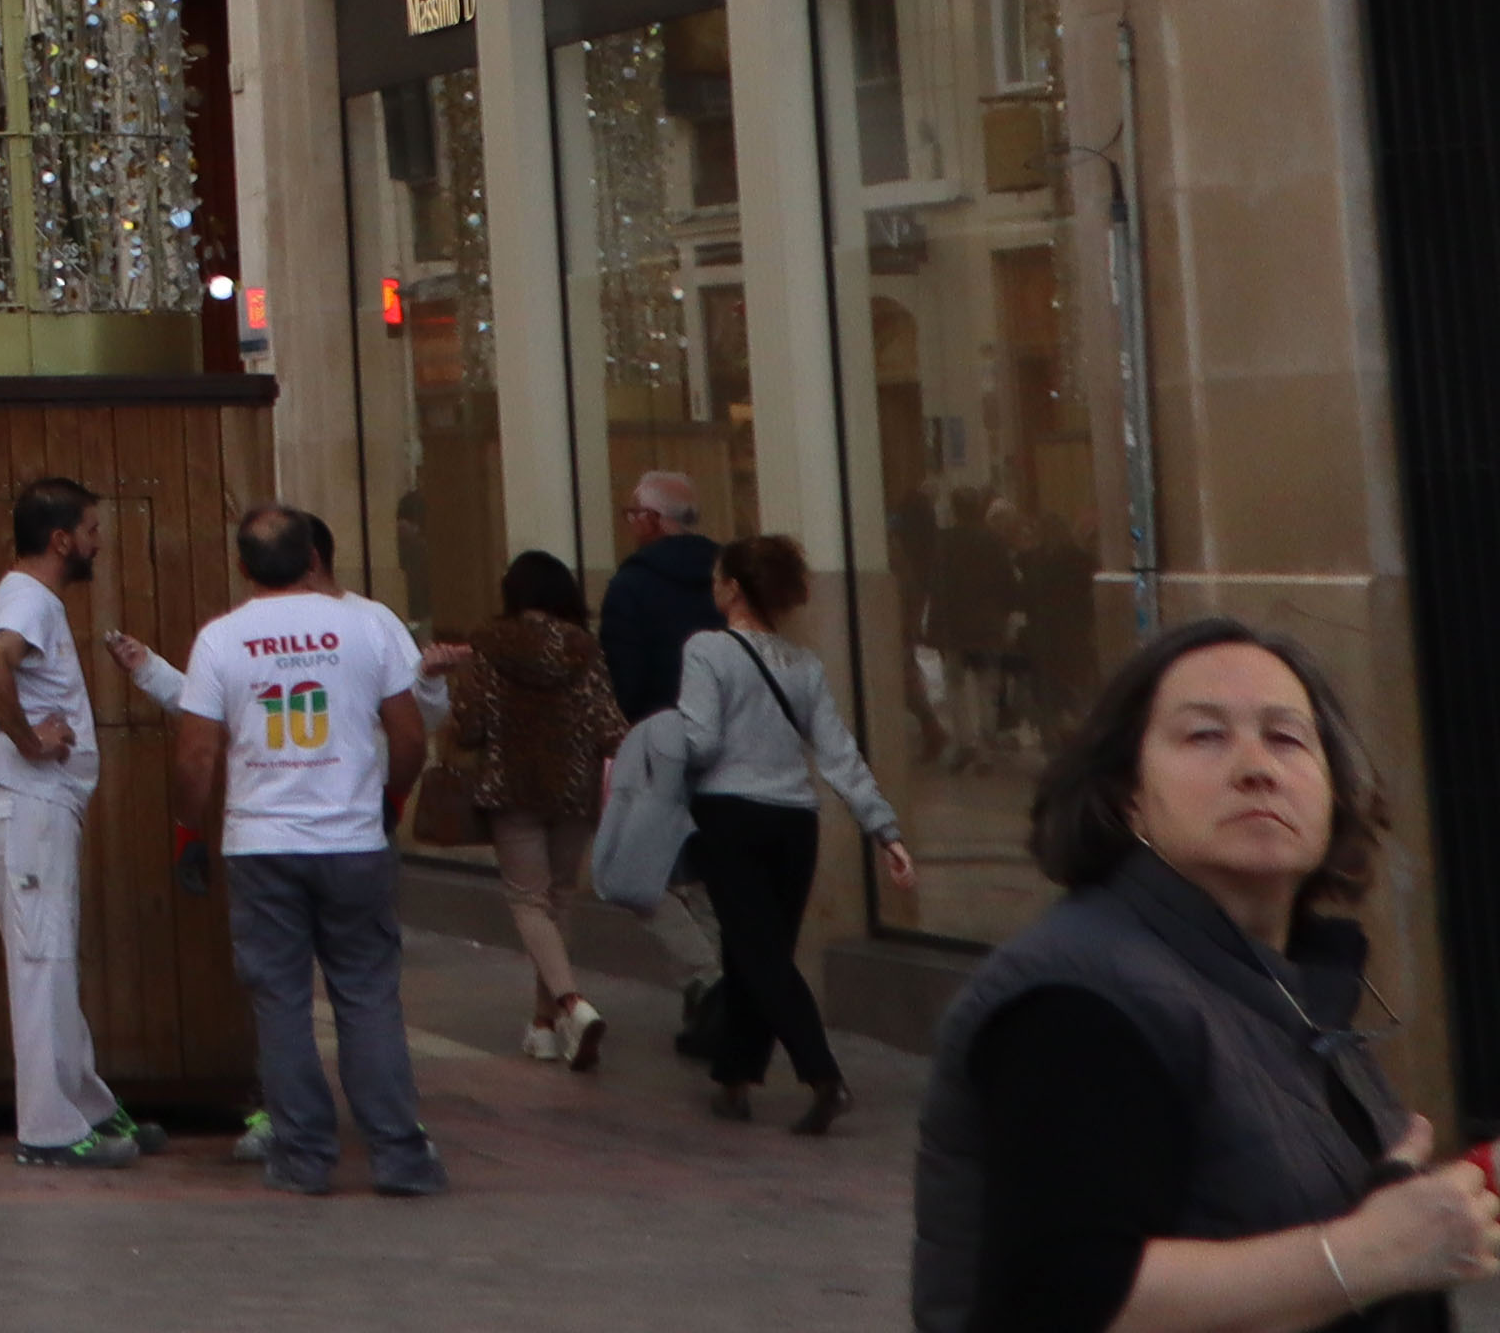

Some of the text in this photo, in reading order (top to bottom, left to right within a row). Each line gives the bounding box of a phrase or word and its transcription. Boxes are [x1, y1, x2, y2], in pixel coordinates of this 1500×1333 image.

[243, 632, 339, 658] TRILLO
[275, 652, 340, 669] GRUPO
[257, 680, 330, 750] 10
